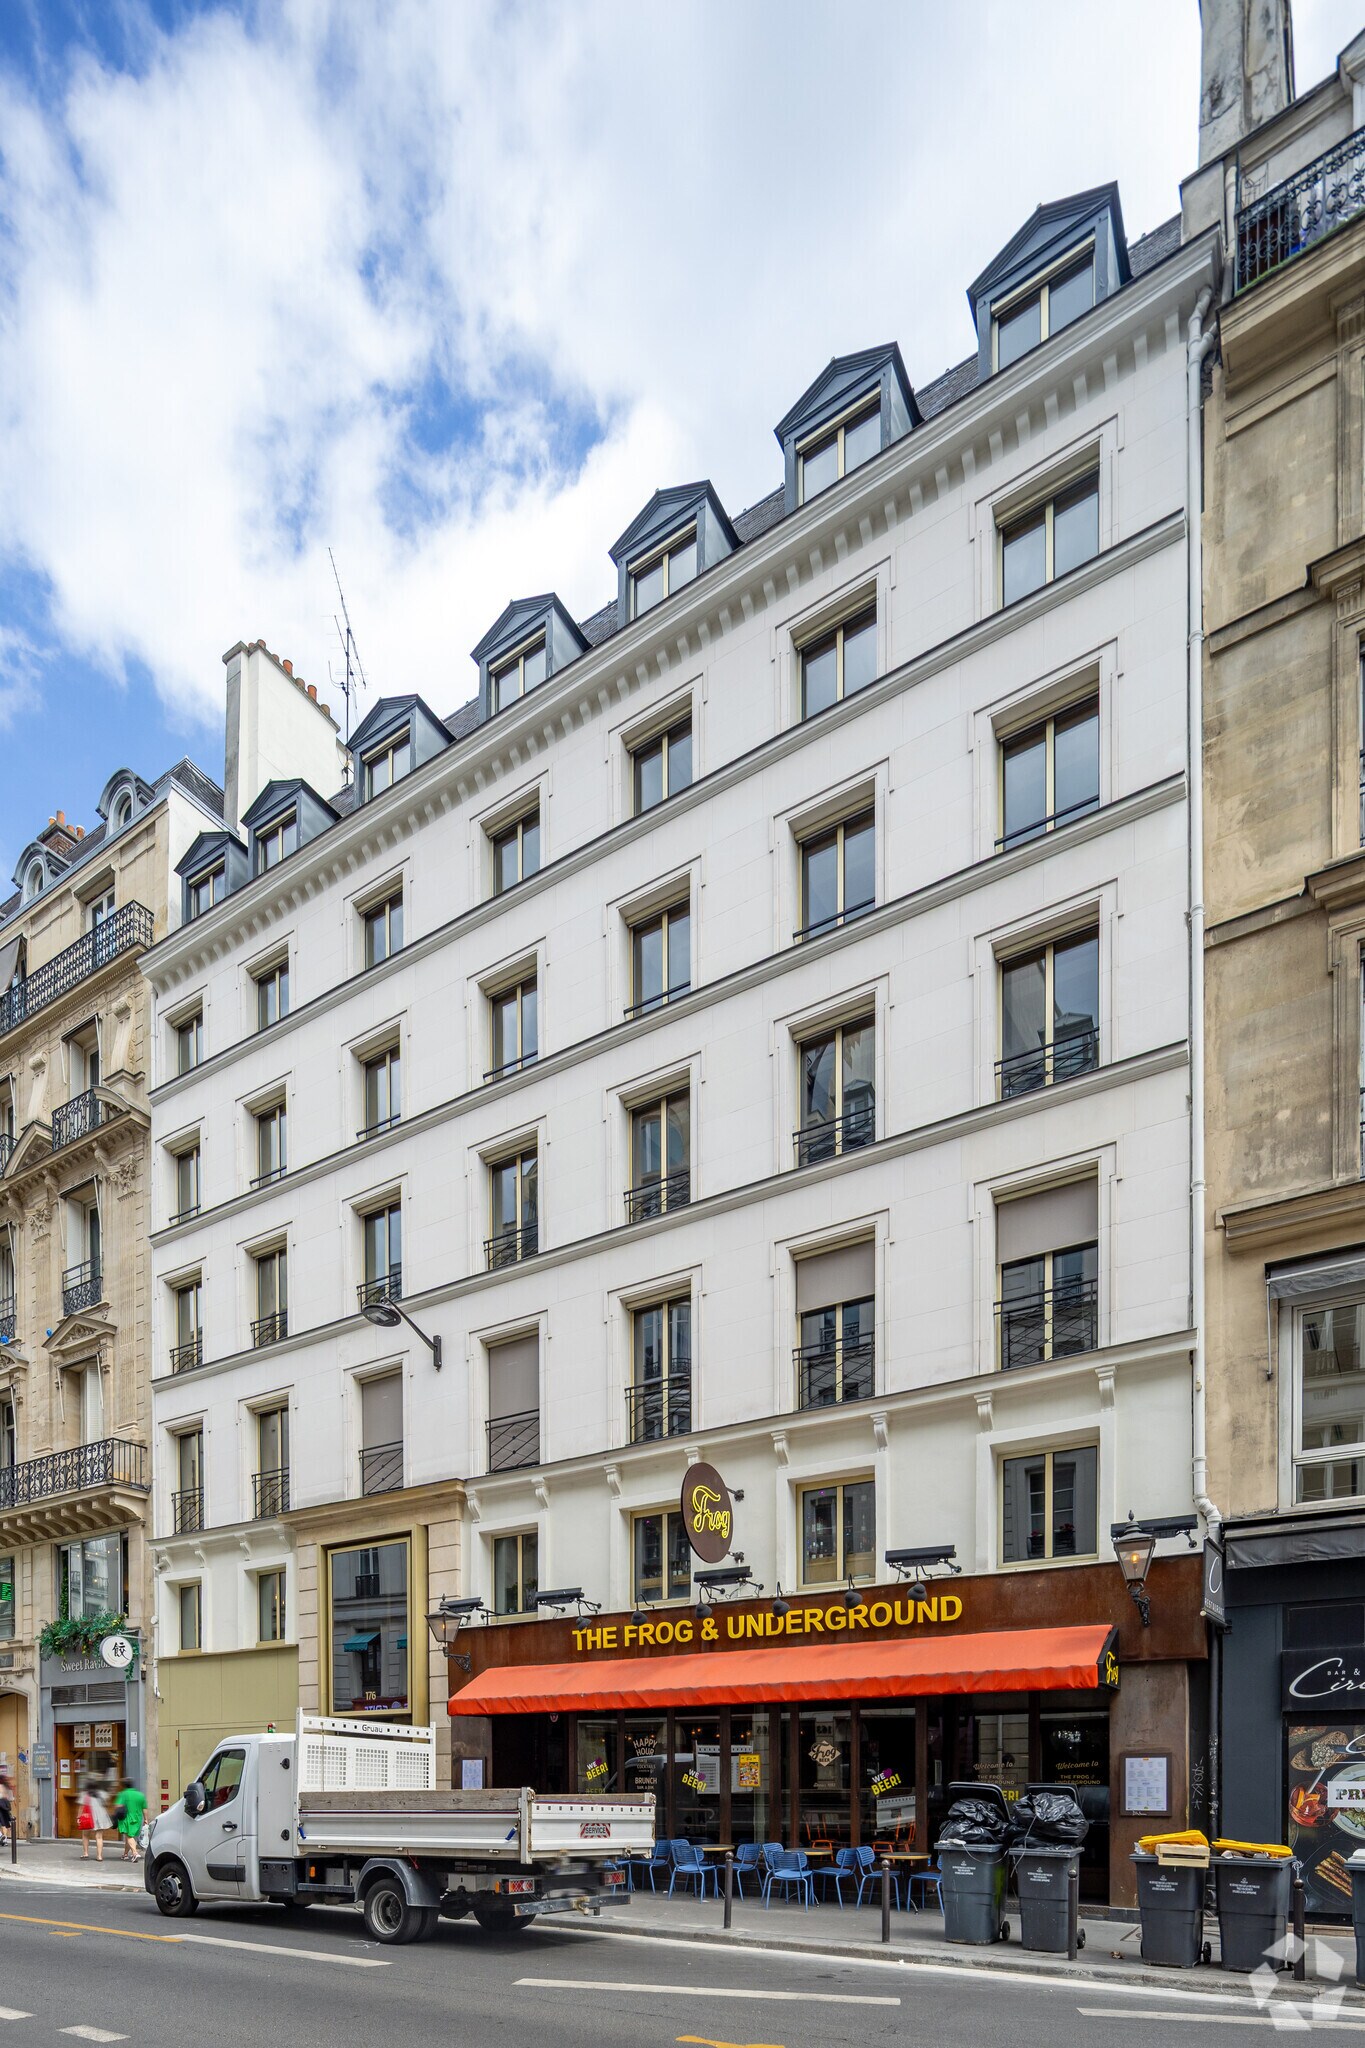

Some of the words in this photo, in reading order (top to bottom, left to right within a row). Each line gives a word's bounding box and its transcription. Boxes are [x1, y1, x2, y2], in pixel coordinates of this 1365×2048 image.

[692, 1485, 730, 1539] Frog
[572, 1626, 617, 1651] THE
[624, 1620, 693, 1647] FROG
[700, 1617, 719, 1641] &
[727, 1595, 963, 1640] UNDERGROUND
[60, 1660, 83, 1673] Sweet
[1353, 1668, 1360, 1676] &
[365, 1691, 377, 1700] 176
[362, 1724, 383, 1733] Gruau
[632, 1738, 658, 1749] HAPPY
[635, 1747, 655, 1756] HOUR
[810, 1742, 837, 1762] Frog
[587, 1761, 597, 1770] WE
[1055, 1762, 1090, 1770] Welcome
[586, 1762, 609, 1780] BEER!
[688, 1769, 699, 1779] WE
[681, 1773, 707, 1792] BEER!
[872, 1773, 885, 1783] WE
[871, 1773, 902, 1796] BEER!
